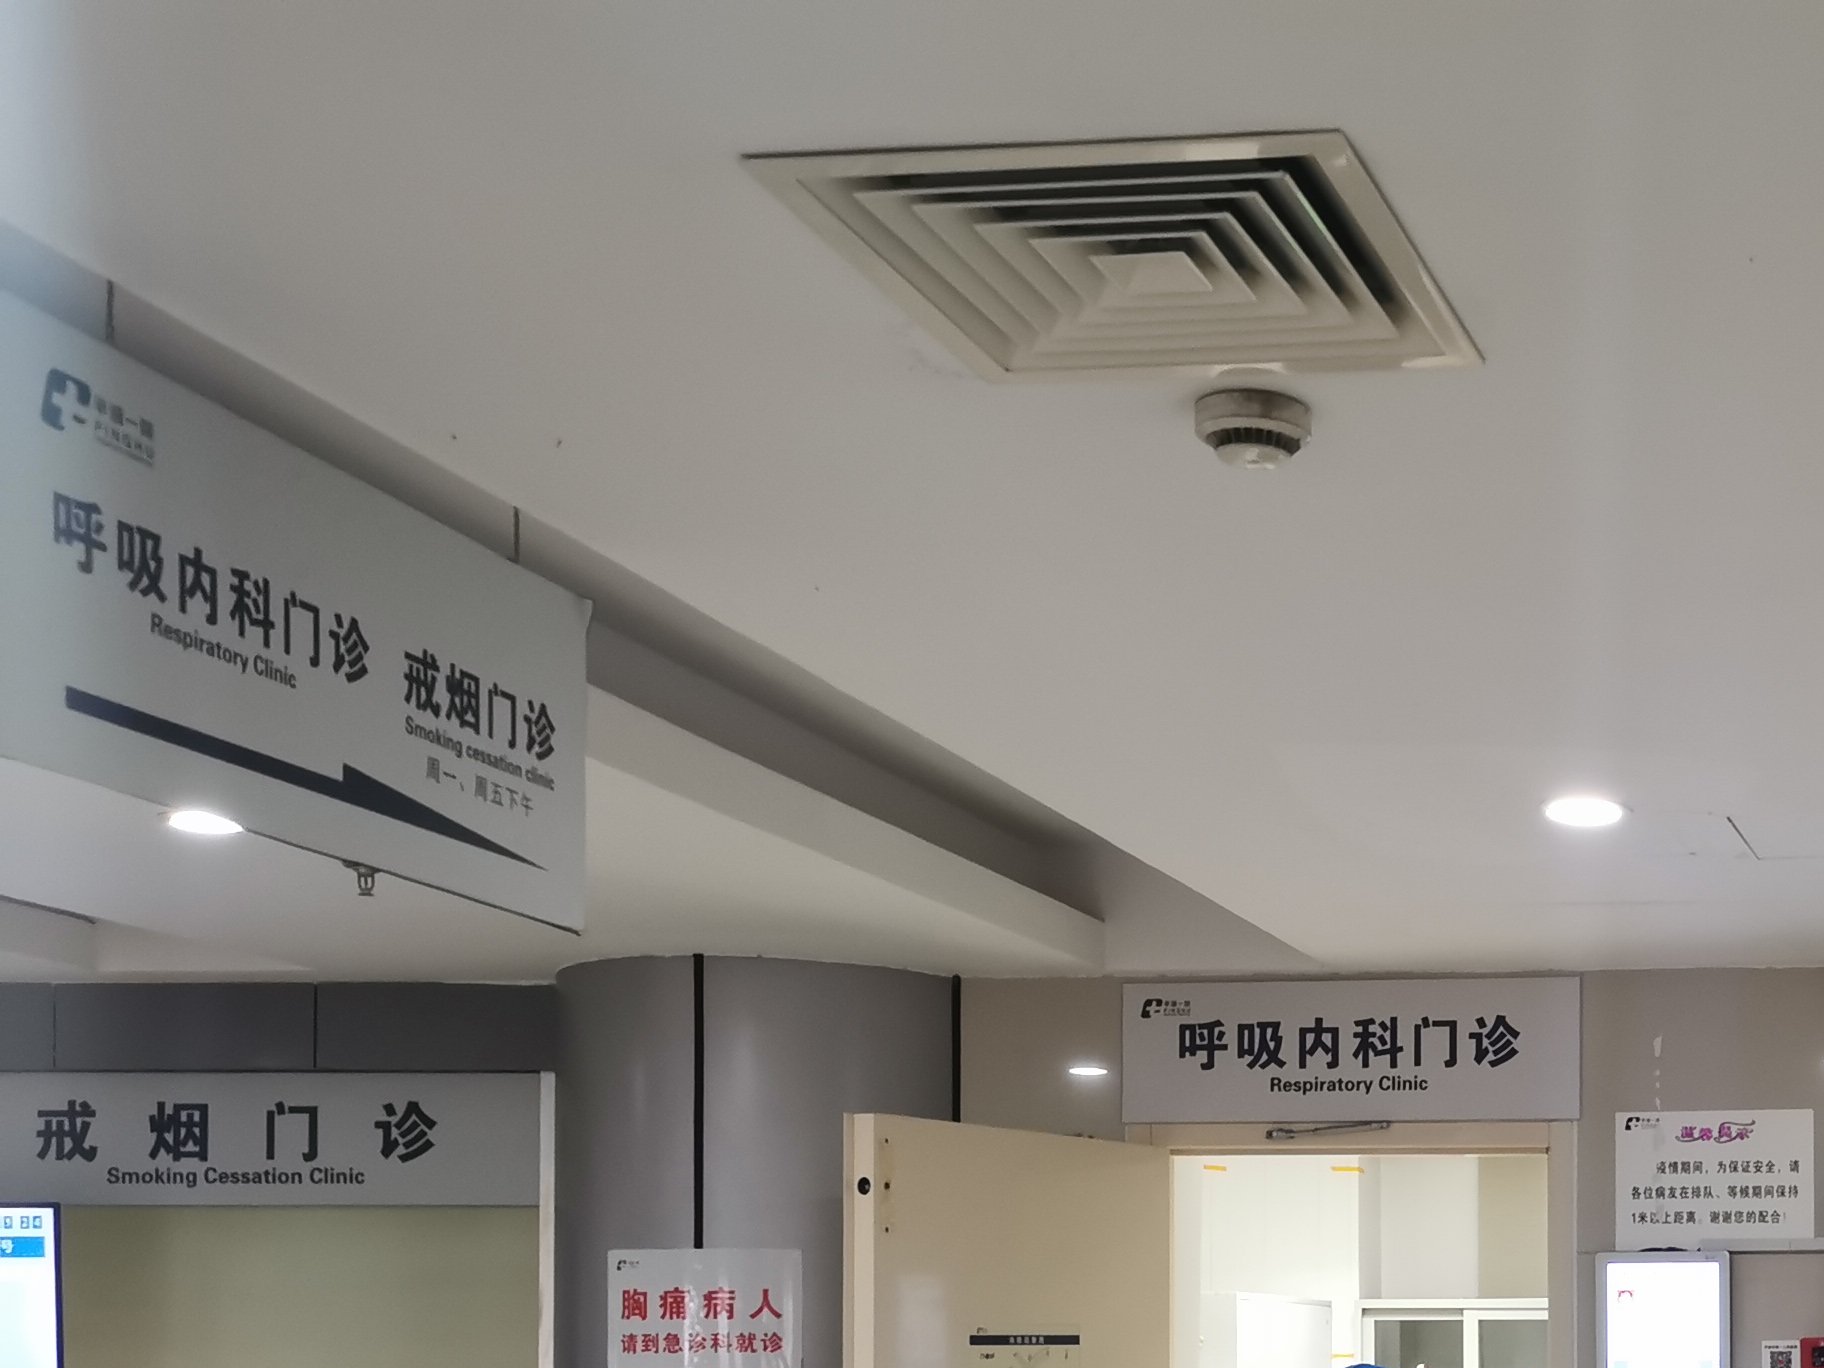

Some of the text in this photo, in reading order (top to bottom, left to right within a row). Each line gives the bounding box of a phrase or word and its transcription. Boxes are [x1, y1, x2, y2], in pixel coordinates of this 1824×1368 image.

[53, 491, 555, 761] 呼吸内科门诊 戒烟门诊
[151, 612, 297, 689] Respiratory Clinic
[405, 715, 463, 758] Smoking
[1178, 1014, 1521, 1071] 呼吸内科门诊
[1270, 1075, 1429, 1096] Respiratory Clinic
[36, 1100, 438, 1163] 戒烟门诊
[107, 1166, 365, 1187] Smoking Cessation Clinic
[621, 1287, 782, 1321] 胸痛病人
[620, 1332, 783, 1355] 请到急诊科就诊
